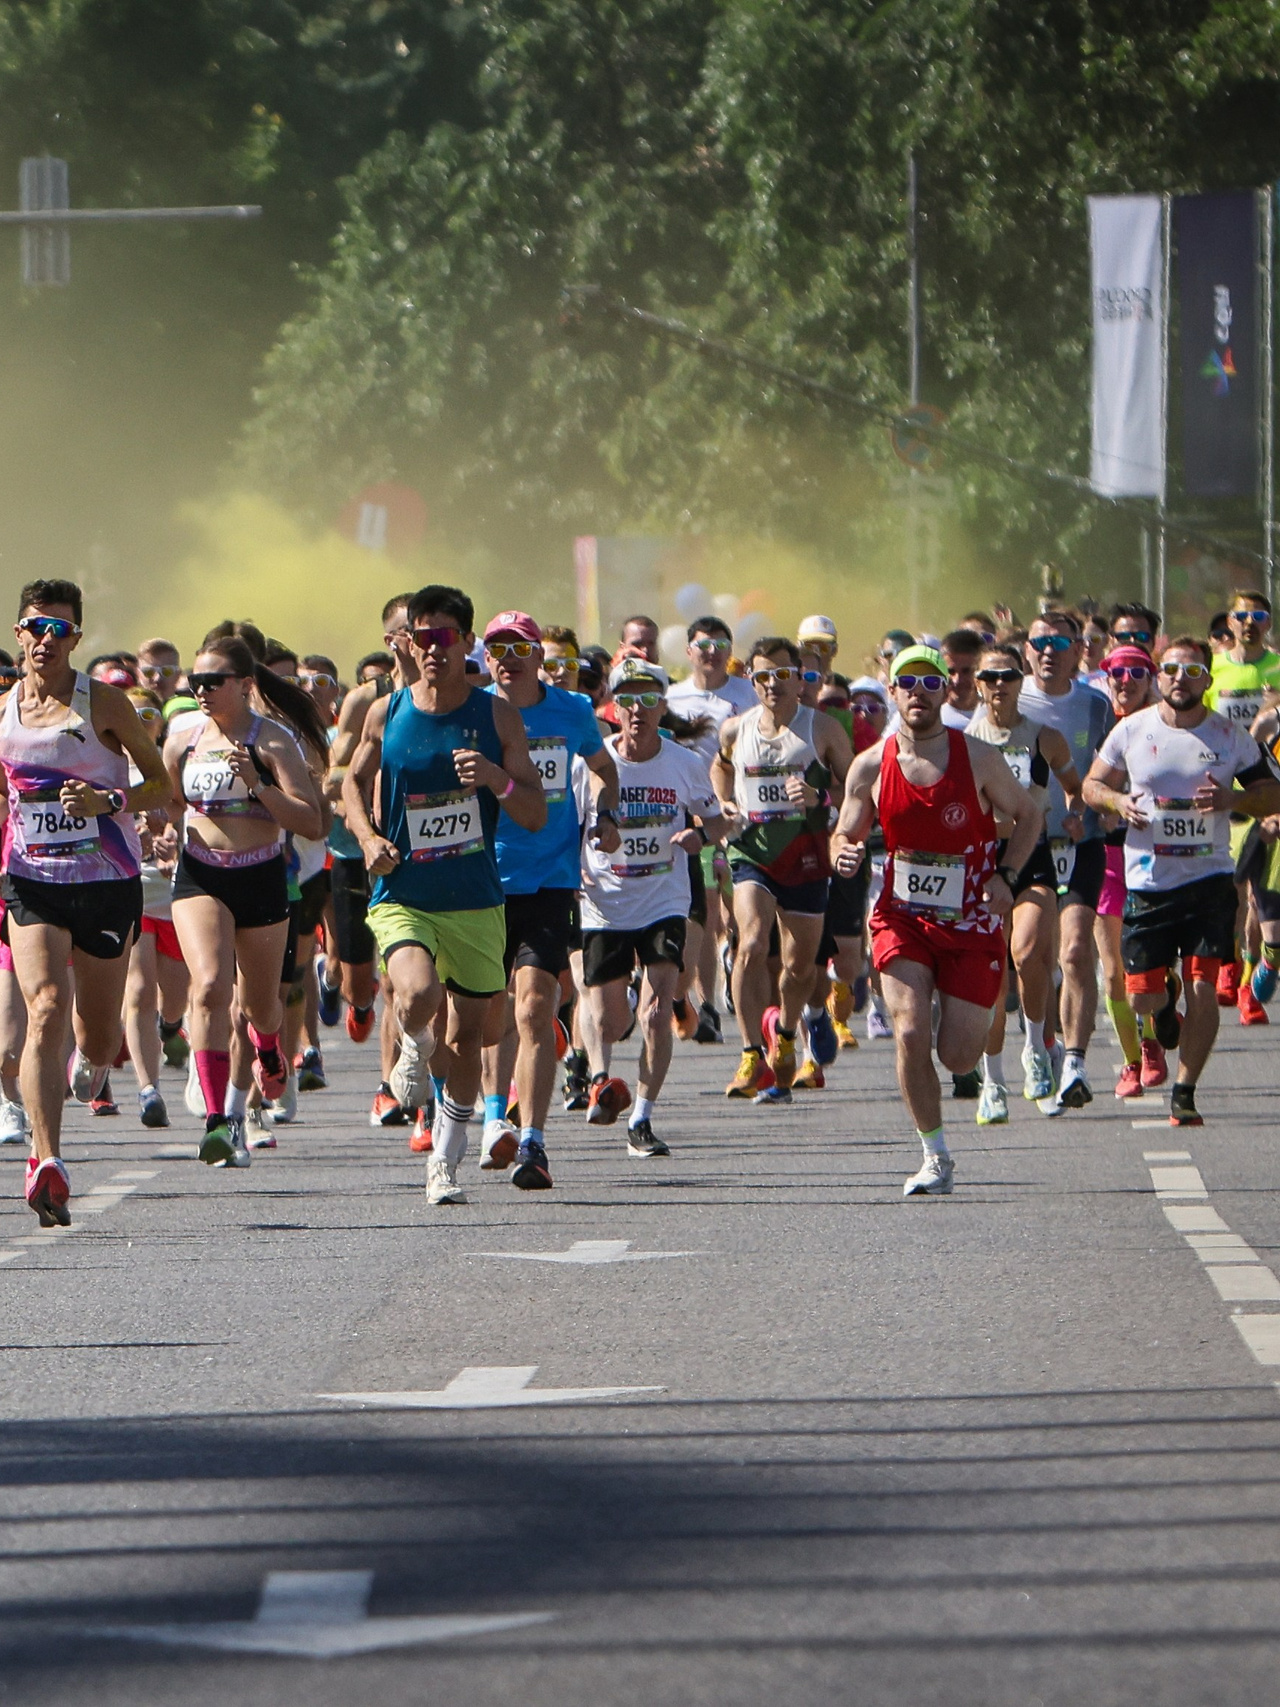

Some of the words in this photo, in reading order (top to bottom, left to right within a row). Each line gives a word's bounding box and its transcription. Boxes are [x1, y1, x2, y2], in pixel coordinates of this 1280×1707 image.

[192, 770, 236, 792] 4397
[419, 812, 472, 839] 4279
[1162, 818, 1207, 837] 5814
[229, 848, 268, 865] NIKE
[623, 837, 660, 857] 356
[907, 873, 947, 896] 847
